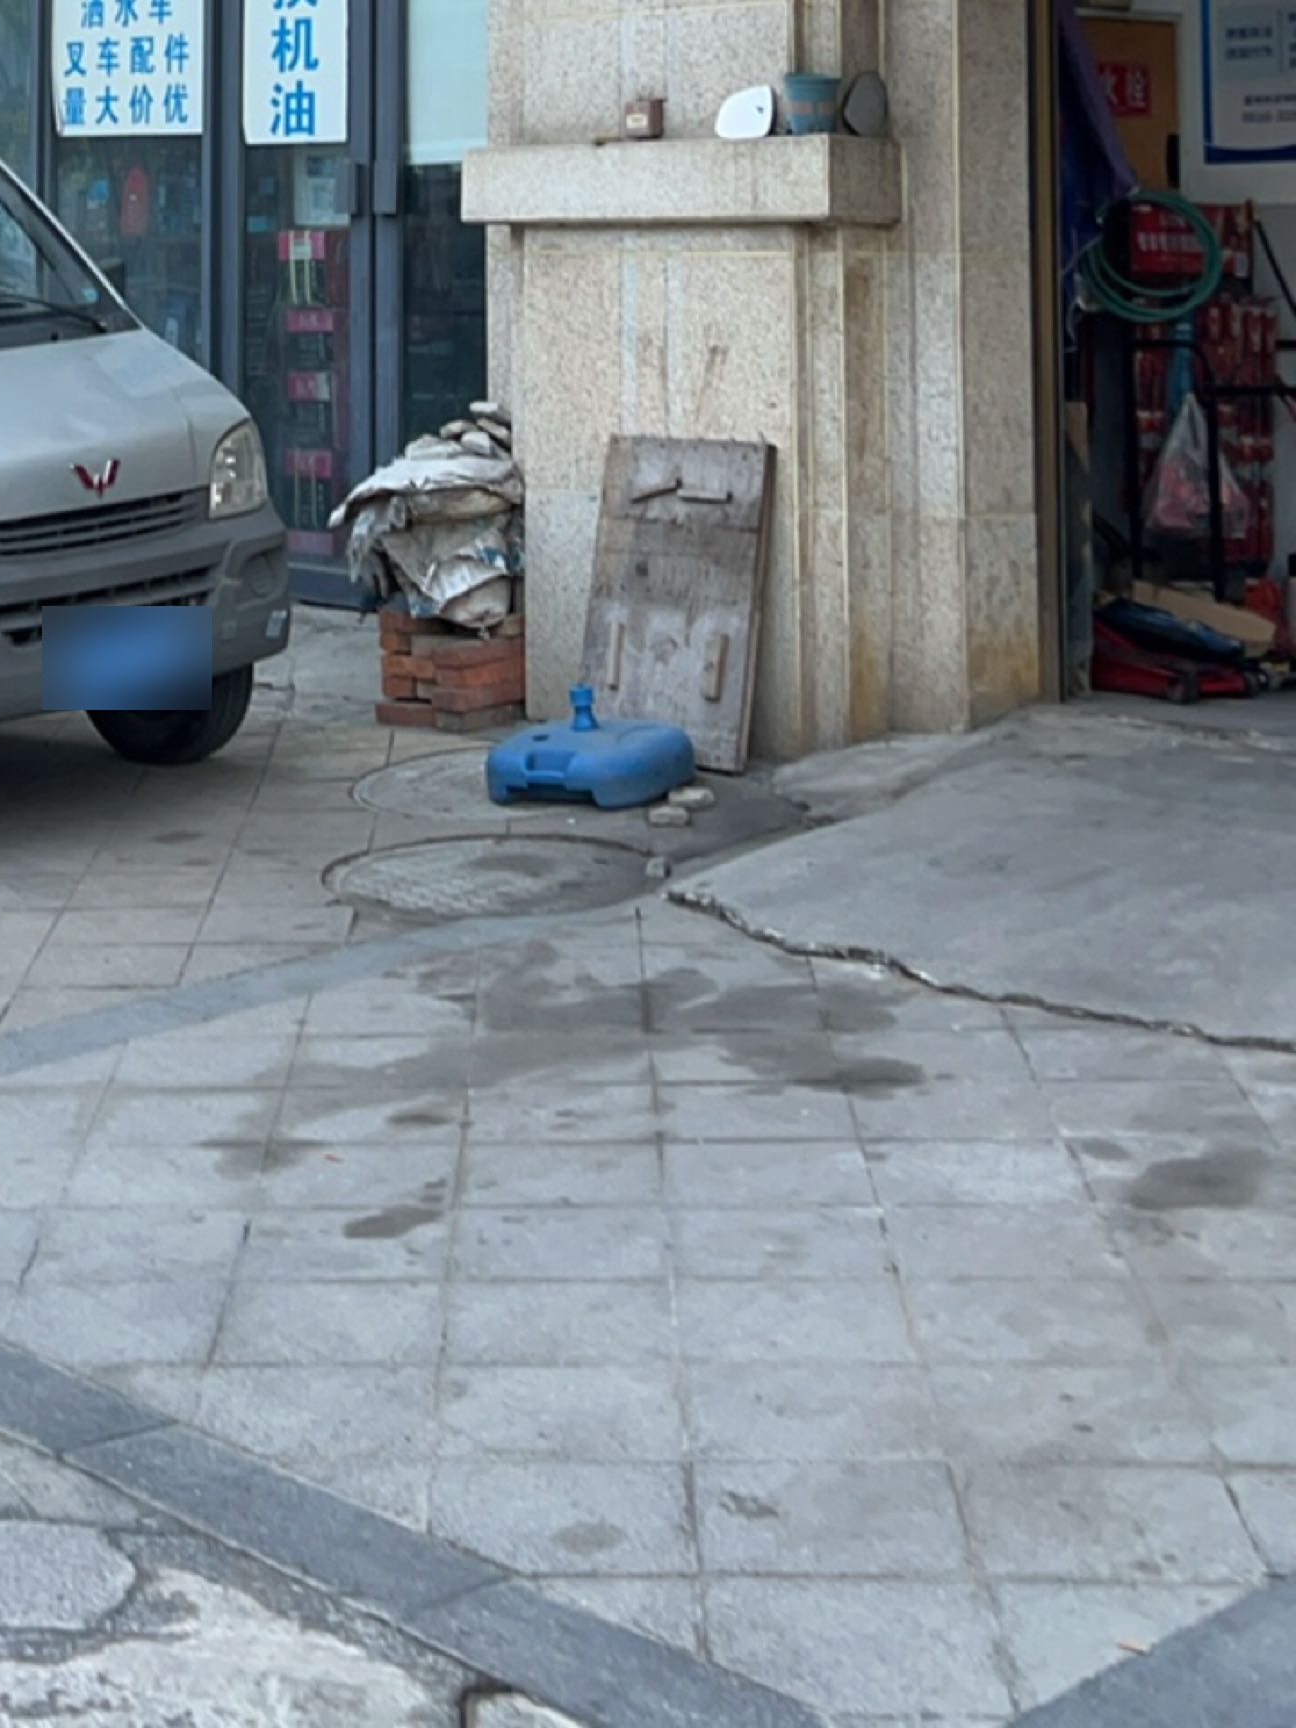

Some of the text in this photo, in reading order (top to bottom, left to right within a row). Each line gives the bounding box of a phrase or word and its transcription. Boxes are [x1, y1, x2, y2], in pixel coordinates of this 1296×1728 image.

[64, 33, 190, 78] 叉车配件
[63, 83, 189, 126] 量大价优
